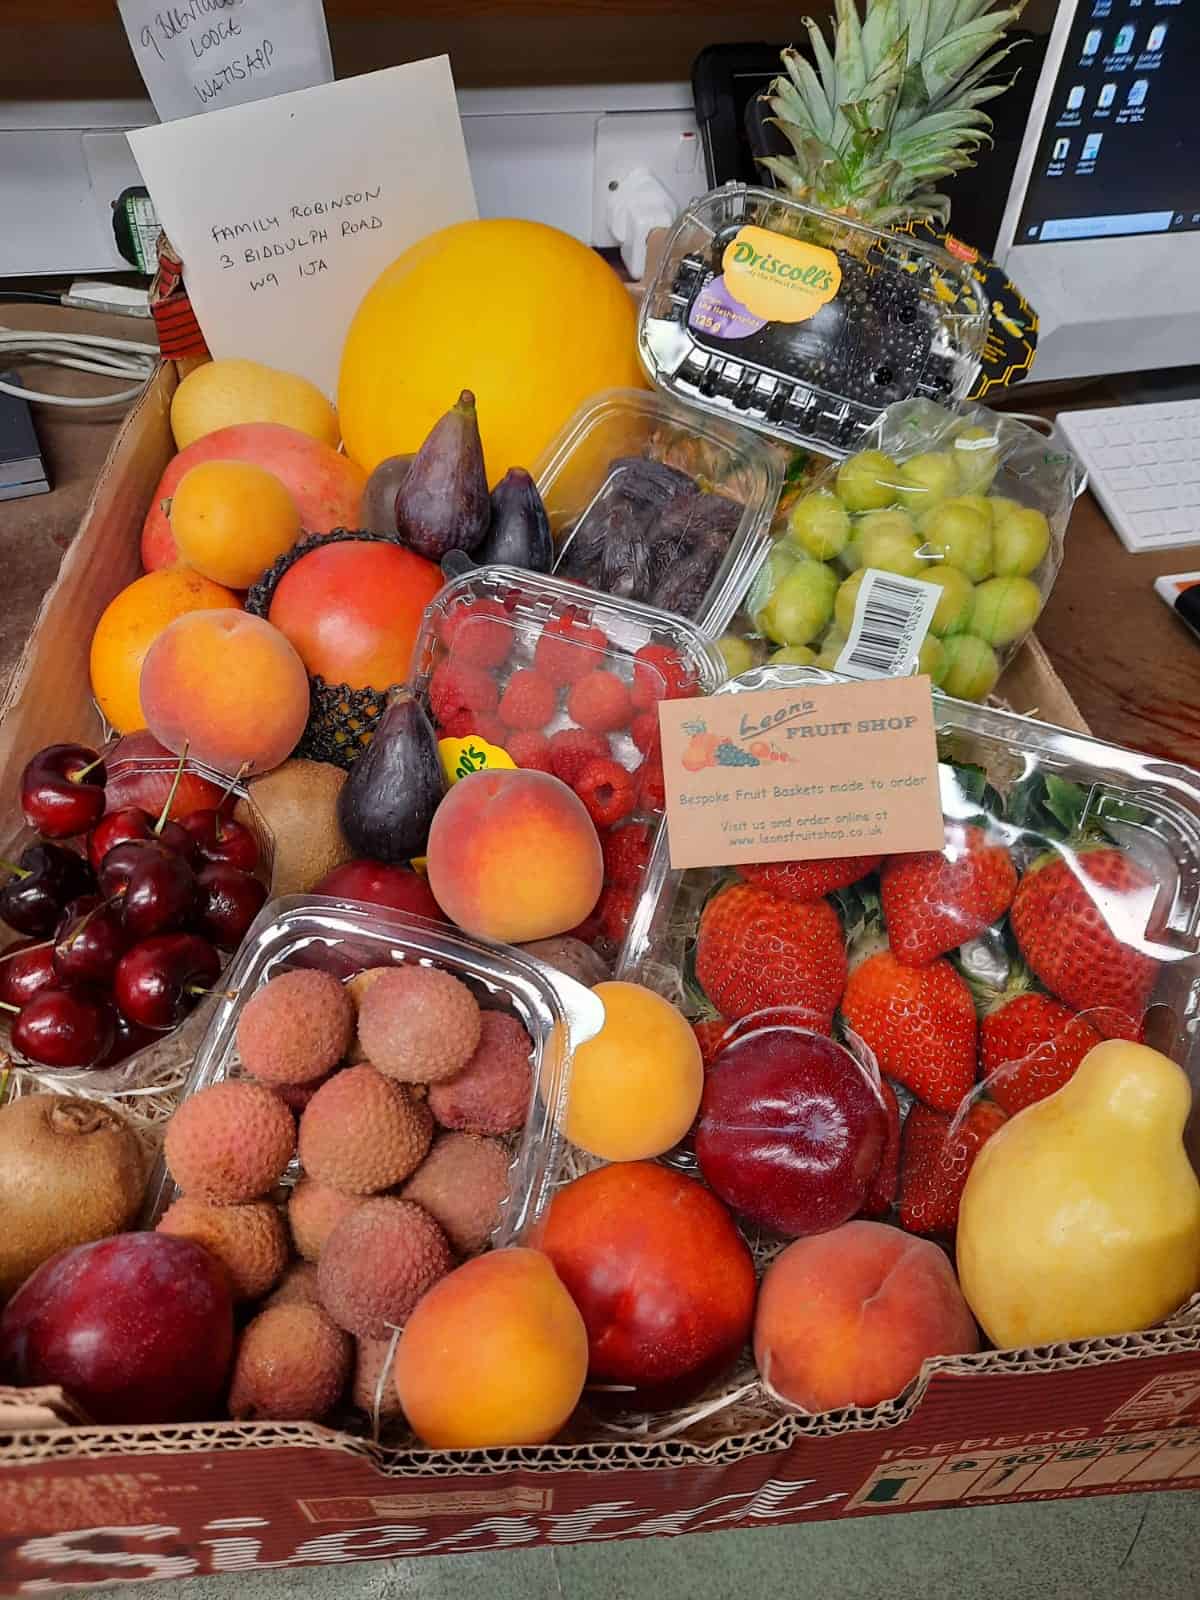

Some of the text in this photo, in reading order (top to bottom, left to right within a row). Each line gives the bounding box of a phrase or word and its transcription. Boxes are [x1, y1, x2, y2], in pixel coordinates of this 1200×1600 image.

[190, 16, 242, 58] LODGE
[211, 186, 382, 243] FAMILY ROBINSON
[219, 216, 383, 270] 3 BIDDULPH ROAD
[733, 241, 834, 292] Driscoll's
[786, 715, 919, 740] FRUIT SHOP
[679, 774, 928, 807] Bespoke Fruit Baskets made to order
[720, 819, 748, 833] Visit
[752, 819, 767, 831] us
[770, 815, 793, 829] and
[796, 813, 832, 827] order
[882, 1426, 1089, 1462] ICEBERG
